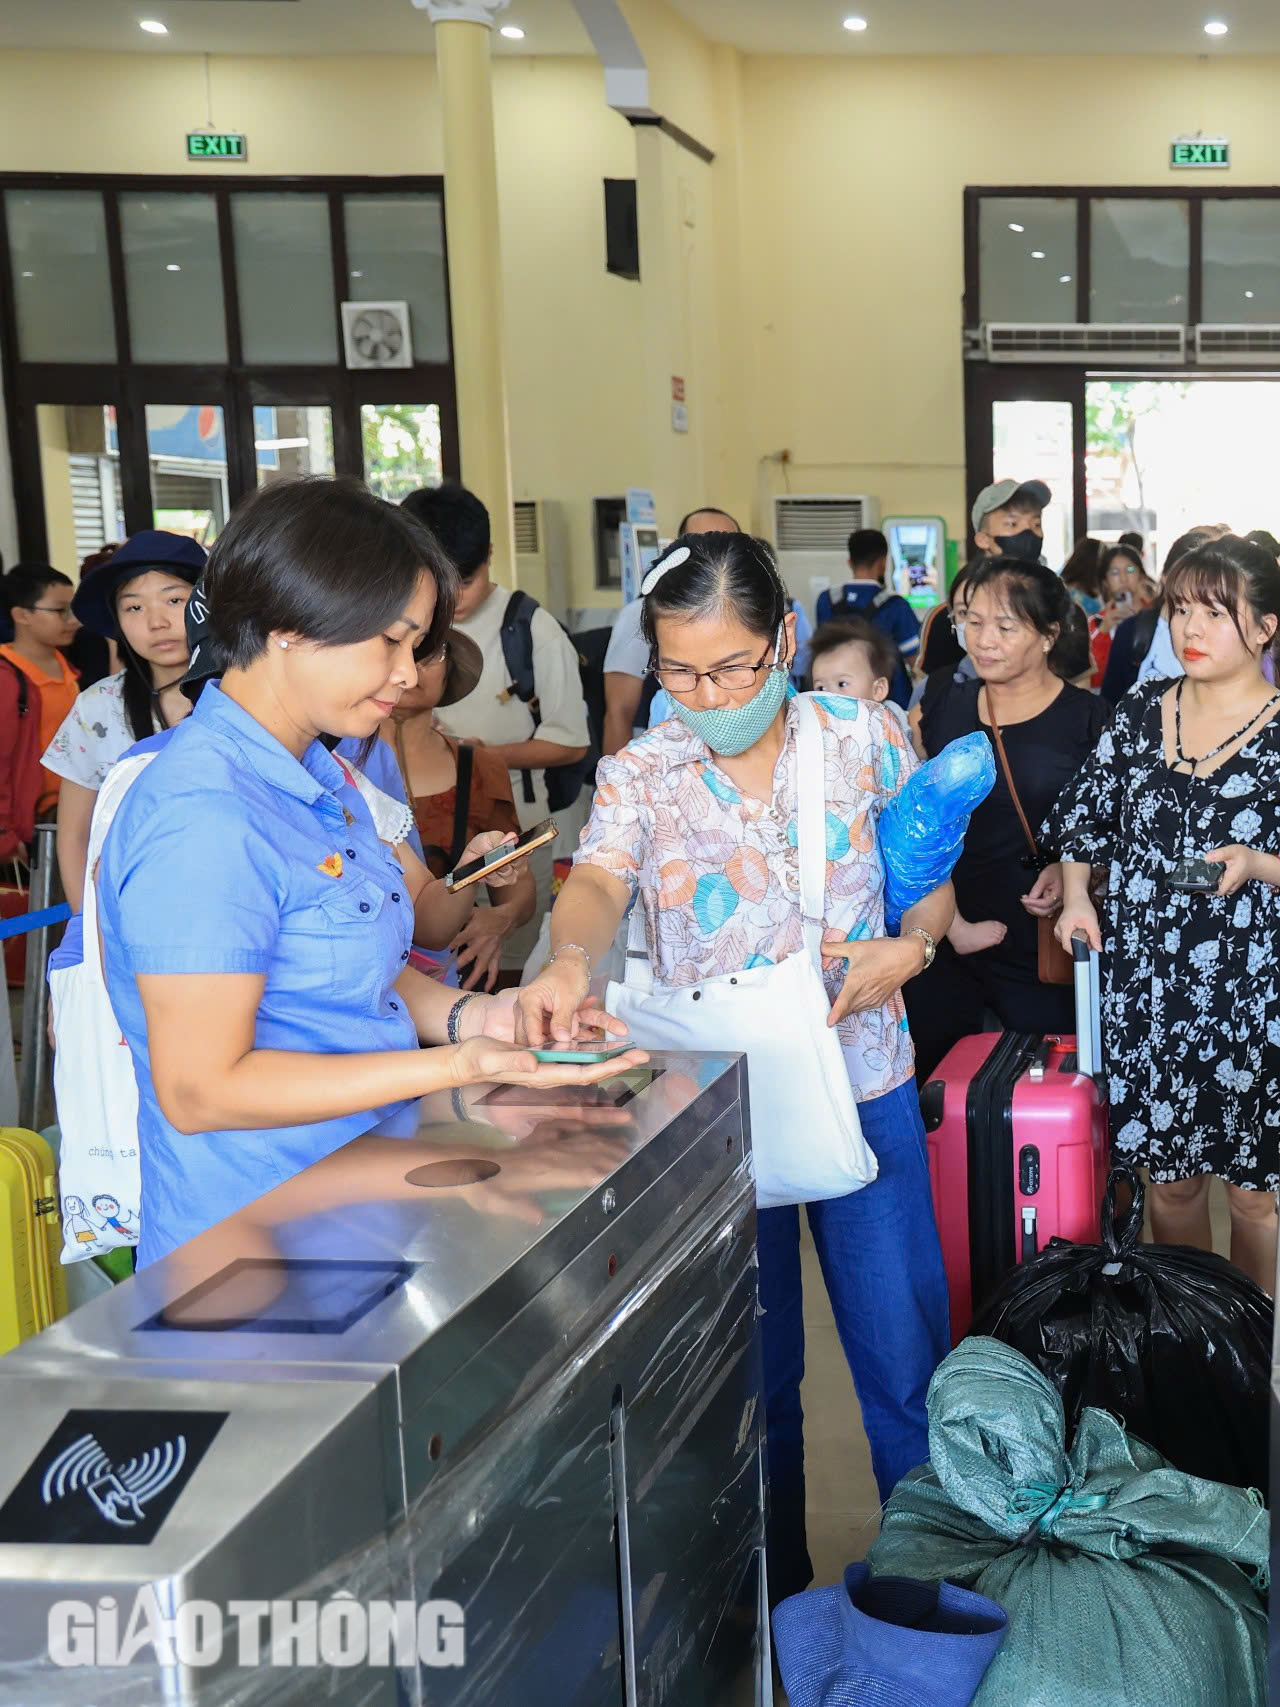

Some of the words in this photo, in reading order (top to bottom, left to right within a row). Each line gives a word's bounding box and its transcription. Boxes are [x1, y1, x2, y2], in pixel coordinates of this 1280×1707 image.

[190, 136, 242, 155] EXIT
[1175, 145, 1225, 163] EXIT
[88, 1146, 114, 1160] chúng
[120, 1148, 137, 1158] ta
